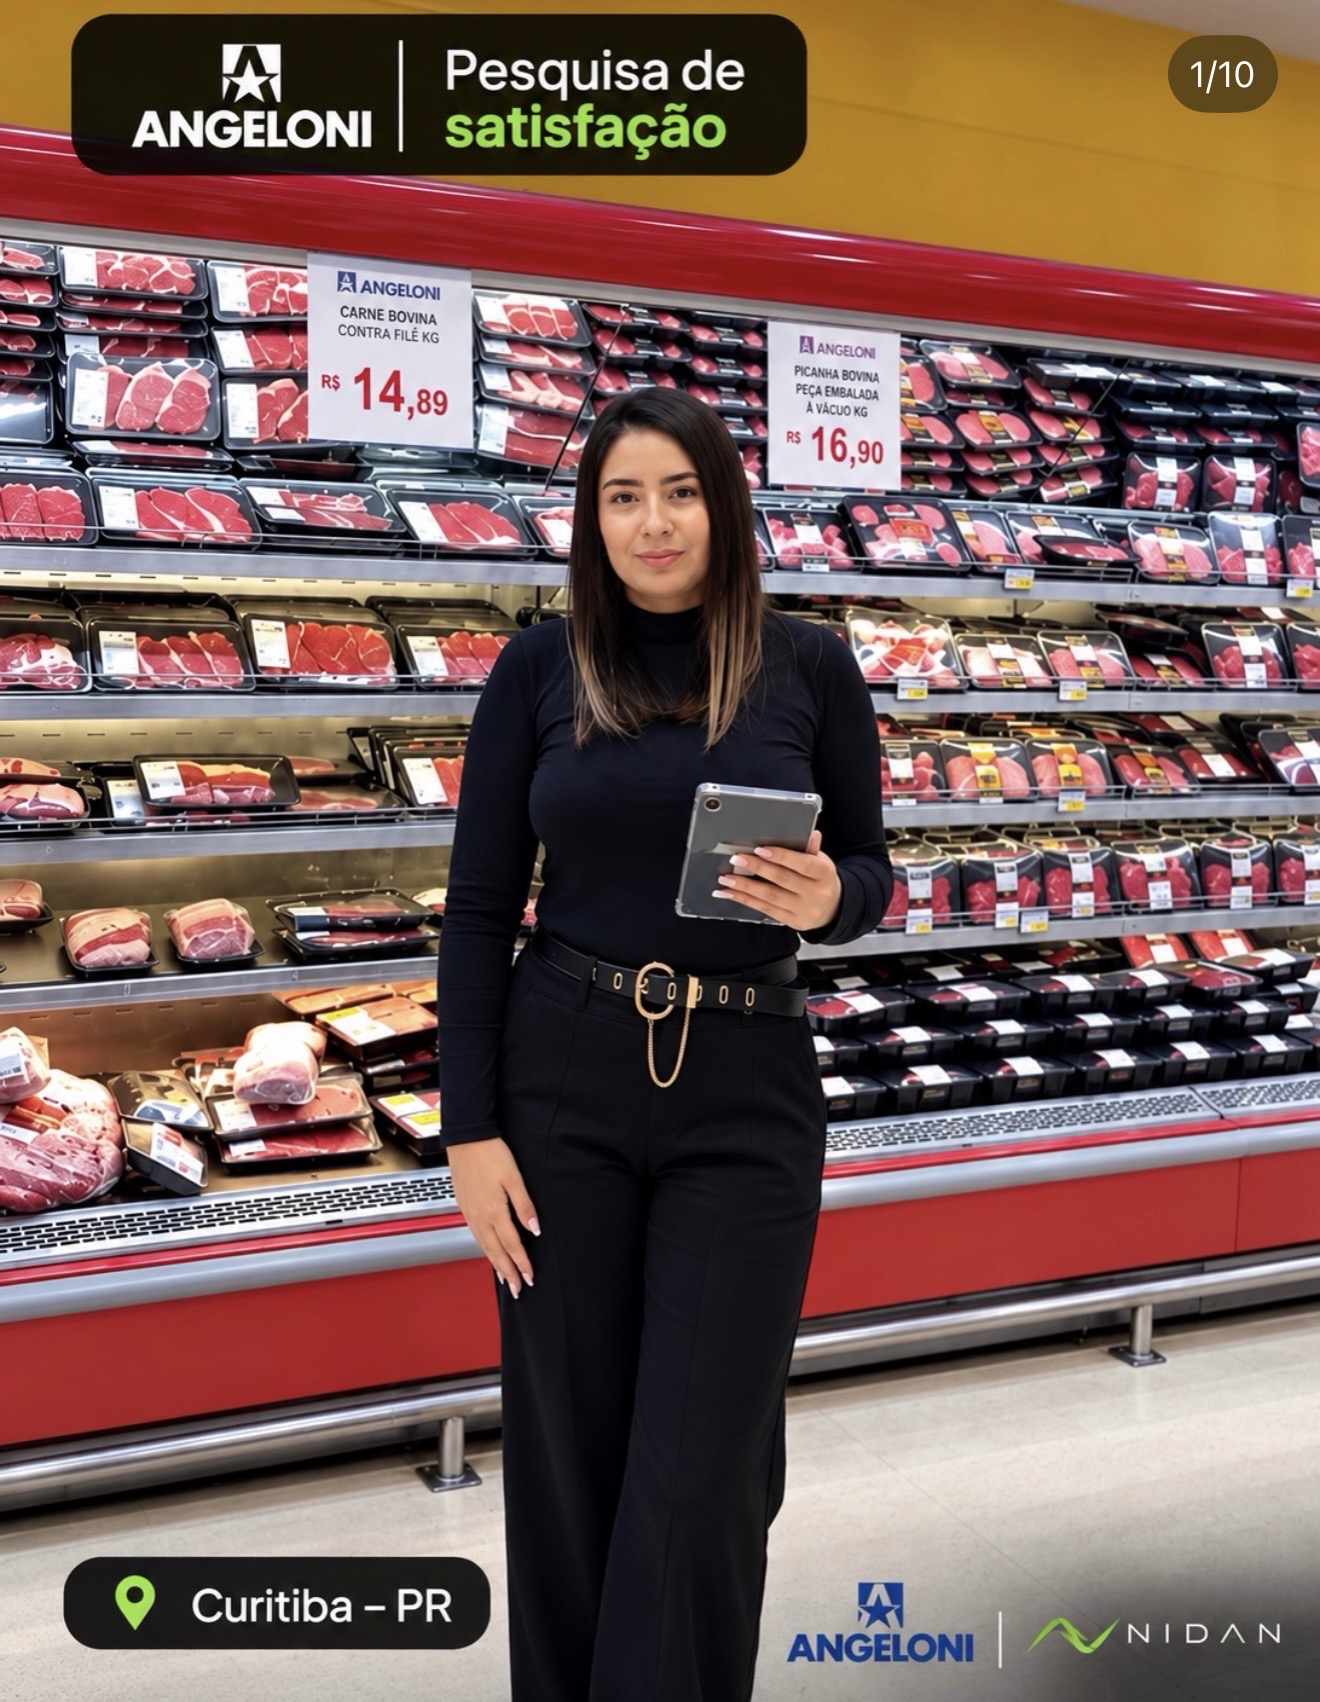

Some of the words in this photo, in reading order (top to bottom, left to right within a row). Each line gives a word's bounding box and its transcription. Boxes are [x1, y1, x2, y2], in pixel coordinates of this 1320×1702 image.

[360, 280, 441, 301] ANGELONI
[340, 305, 385, 321] CARNE
[388, 309, 438, 326] BOVINA
[338, 323, 391, 340] CONTRA
[422, 331, 440, 344] KG
[816, 342, 876, 360] ANGELONI
[794, 364, 840, 380] PICANHA
[841, 369, 880, 384] BOVINA
[321, 374, 341, 391] R$
[354, 366, 449, 421] 14,89
[796, 382, 823, 399] PEÇA
[824, 385, 880, 401] EMBALADA
[816, 401, 851, 417] VÁCUO
[853, 405, 868, 418] KG
[786, 430, 802, 445] R$
[811, 425, 884, 470] 16,90
